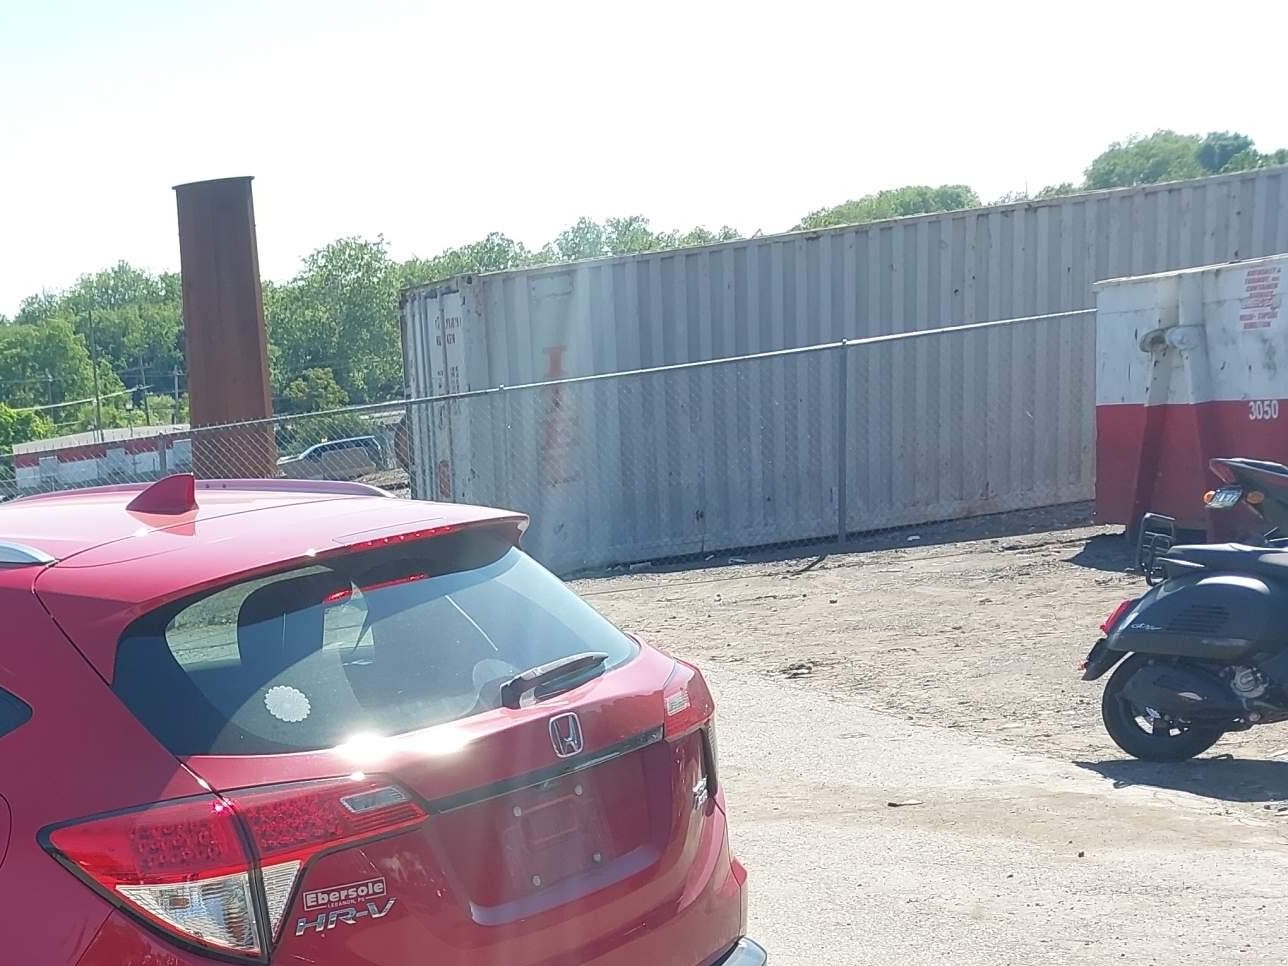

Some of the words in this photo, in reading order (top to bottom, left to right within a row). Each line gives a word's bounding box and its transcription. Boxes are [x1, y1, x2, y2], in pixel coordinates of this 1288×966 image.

[1248, 399, 1279, 420] 3050
[306, 882, 384, 907] Ebersole
[295, 896, 398, 936] HR-V
